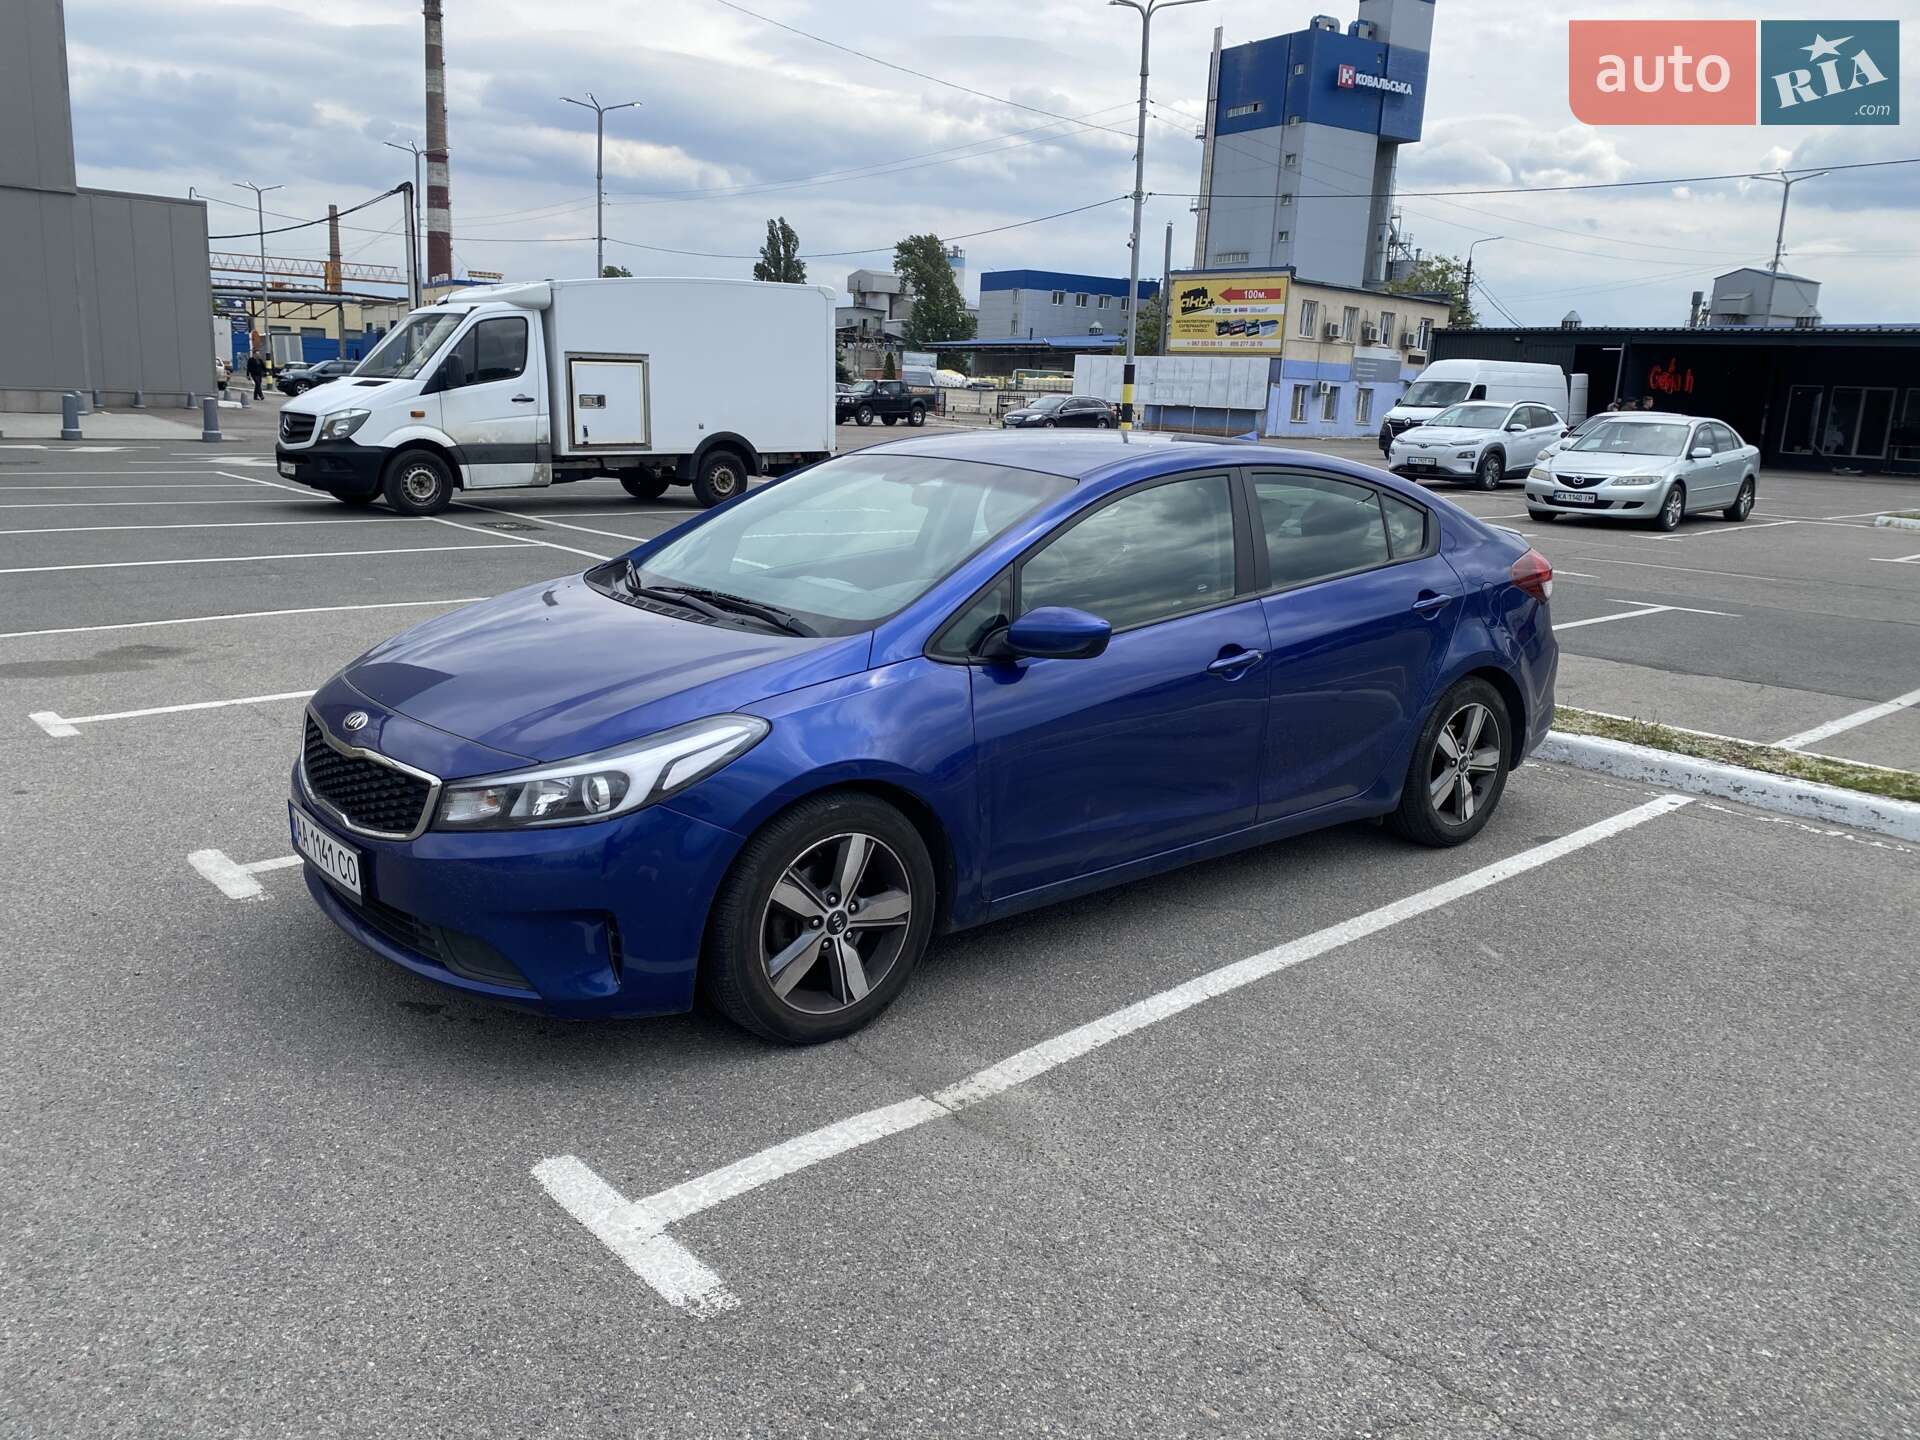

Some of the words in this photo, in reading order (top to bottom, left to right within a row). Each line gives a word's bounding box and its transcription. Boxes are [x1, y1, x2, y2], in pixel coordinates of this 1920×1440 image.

[1355, 72, 1413, 95] КОВАЛЬСЬКА
[296, 815, 310, 851] AA
[311, 829, 335, 873] 1141
[338, 849, 357, 886] CO
